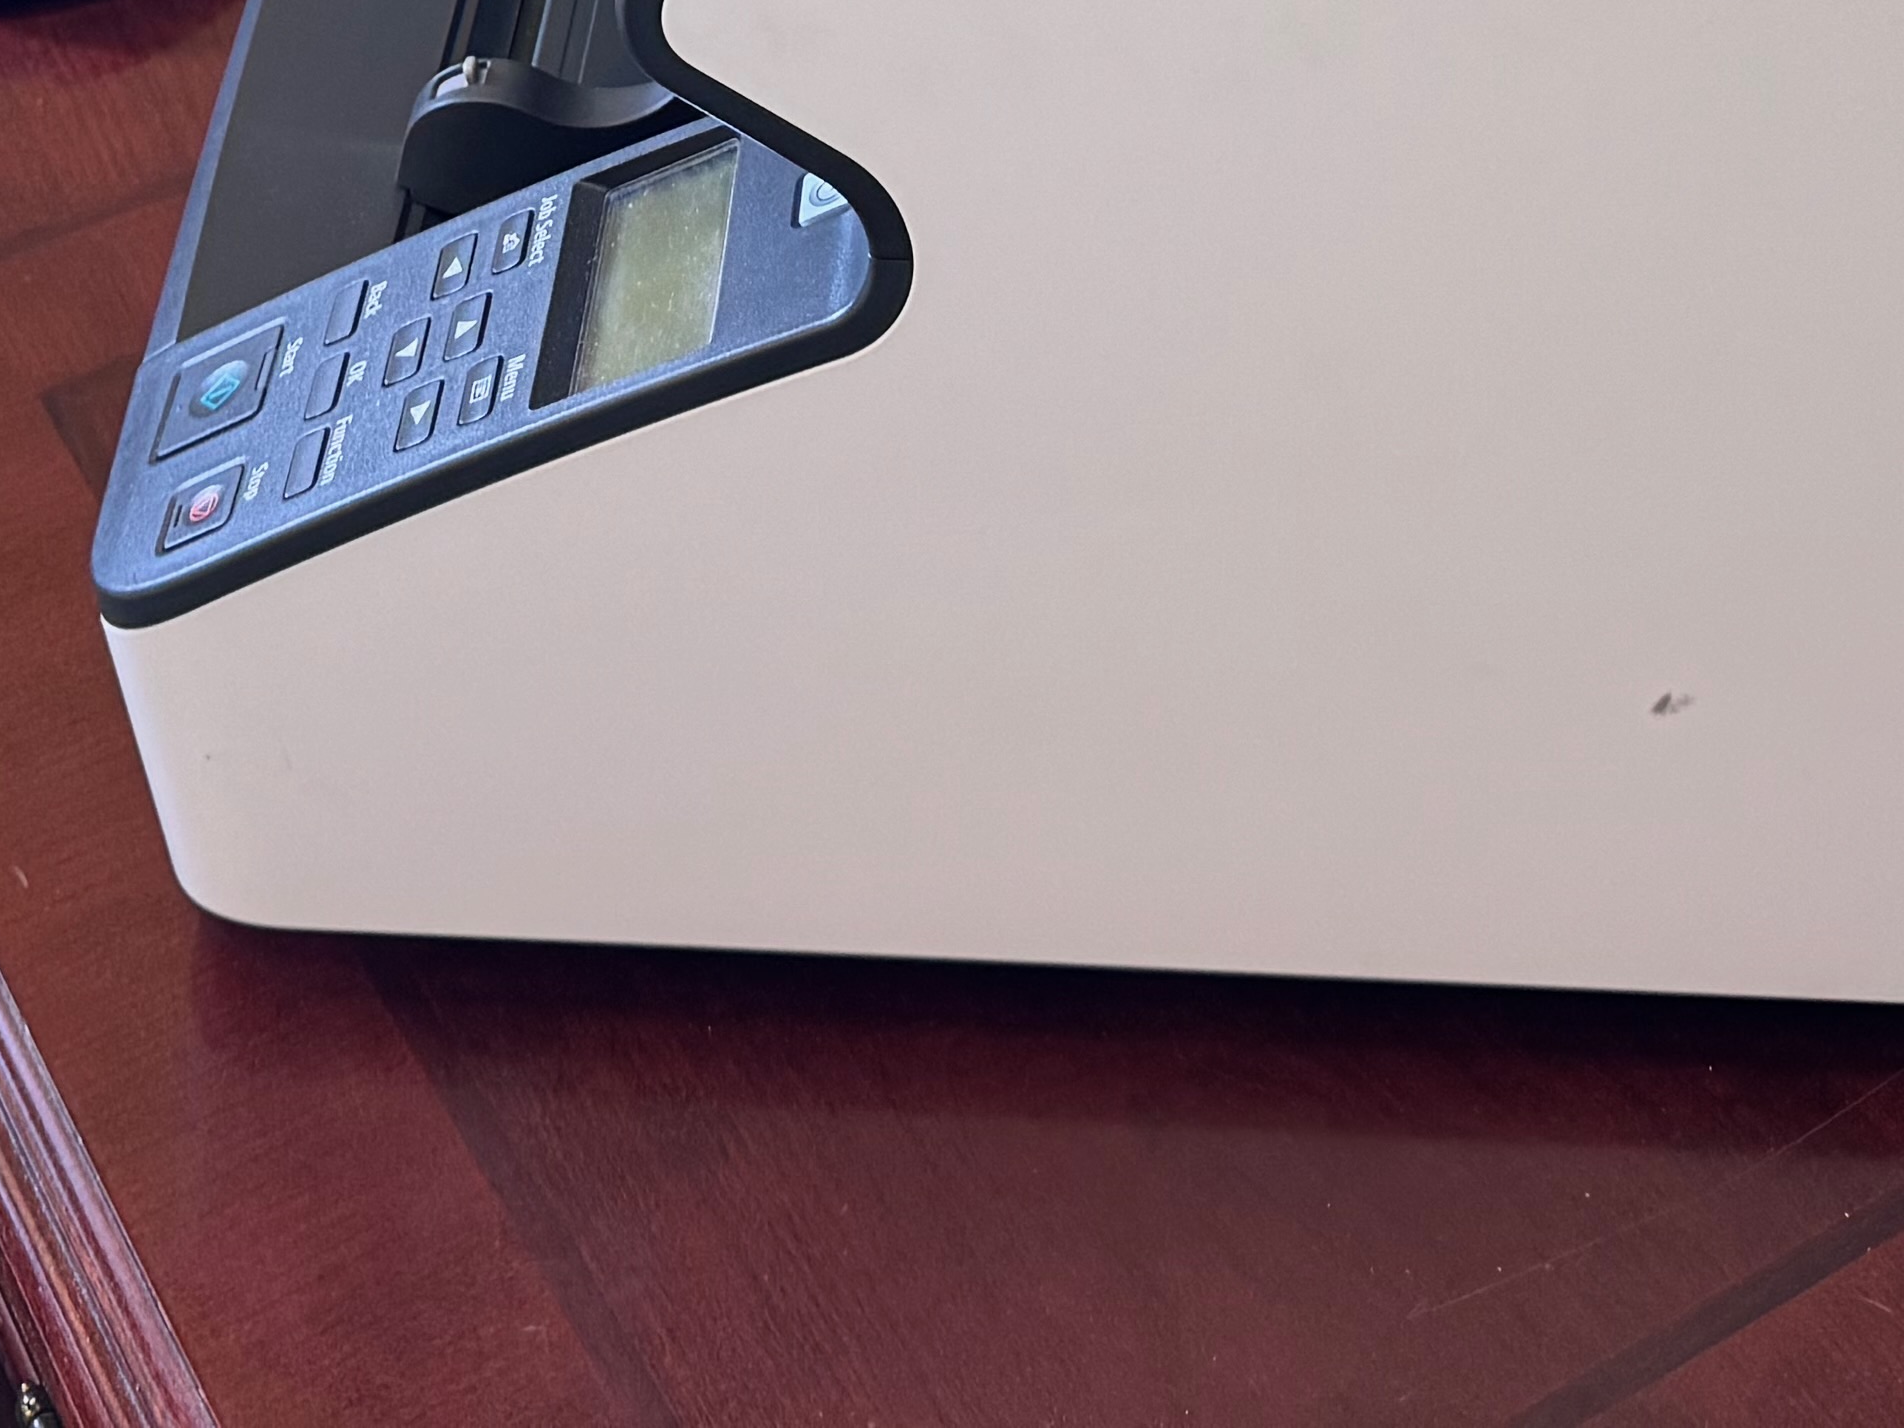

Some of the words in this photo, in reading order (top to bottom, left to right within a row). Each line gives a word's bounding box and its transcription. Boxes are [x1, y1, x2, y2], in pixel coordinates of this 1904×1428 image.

[536, 194, 559, 221] Job
[527, 220, 552, 268] Select
[364, 280, 388, 320] Back
[279, 337, 304, 377] Start
[346, 360, 367, 386] OK
[500, 353, 527, 403] Menu
[320, 414, 353, 486] Function
[243, 462, 269, 501] Stop
